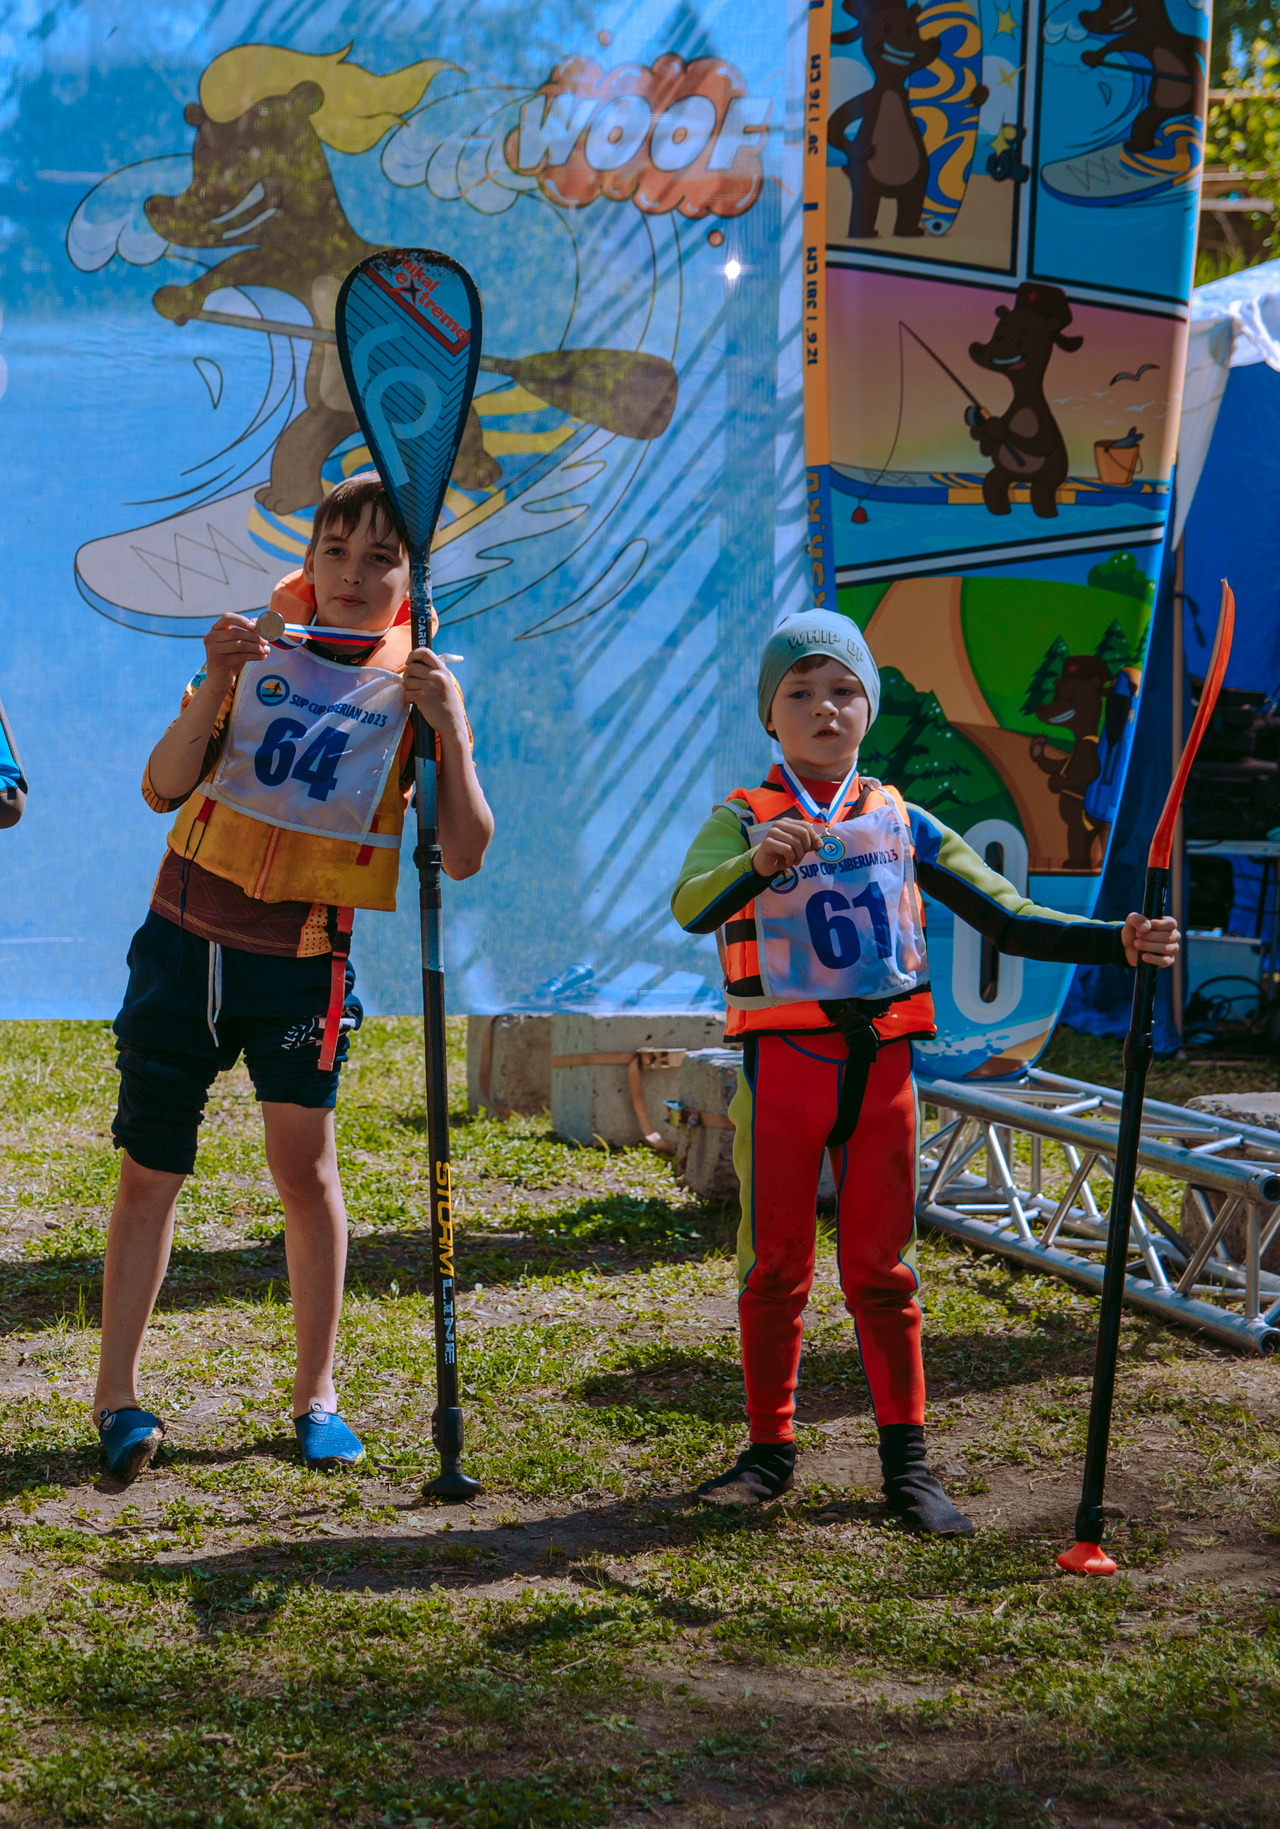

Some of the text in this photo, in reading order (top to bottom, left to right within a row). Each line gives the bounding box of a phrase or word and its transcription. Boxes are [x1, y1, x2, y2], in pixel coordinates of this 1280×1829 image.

[810, 54, 822, 84] CM
[809, 88, 821, 112] 76
[518, 94, 773, 174] WOOF
[806, 246, 818, 275] CM
[806, 280, 818, 310] 381
[417, 615, 427, 648] CARB
[787, 629, 865, 662] WHIP UP
[289, 694, 310, 709] SUP
[308, 702, 327, 717] CUP
[360, 710, 388, 728] 2023
[253, 717, 351, 802] 64
[799, 863, 819, 880] SUP
[819, 861, 838, 876] CUP
[838, 851, 880, 874] SIBERIAN
[805, 881, 893, 970] 61
